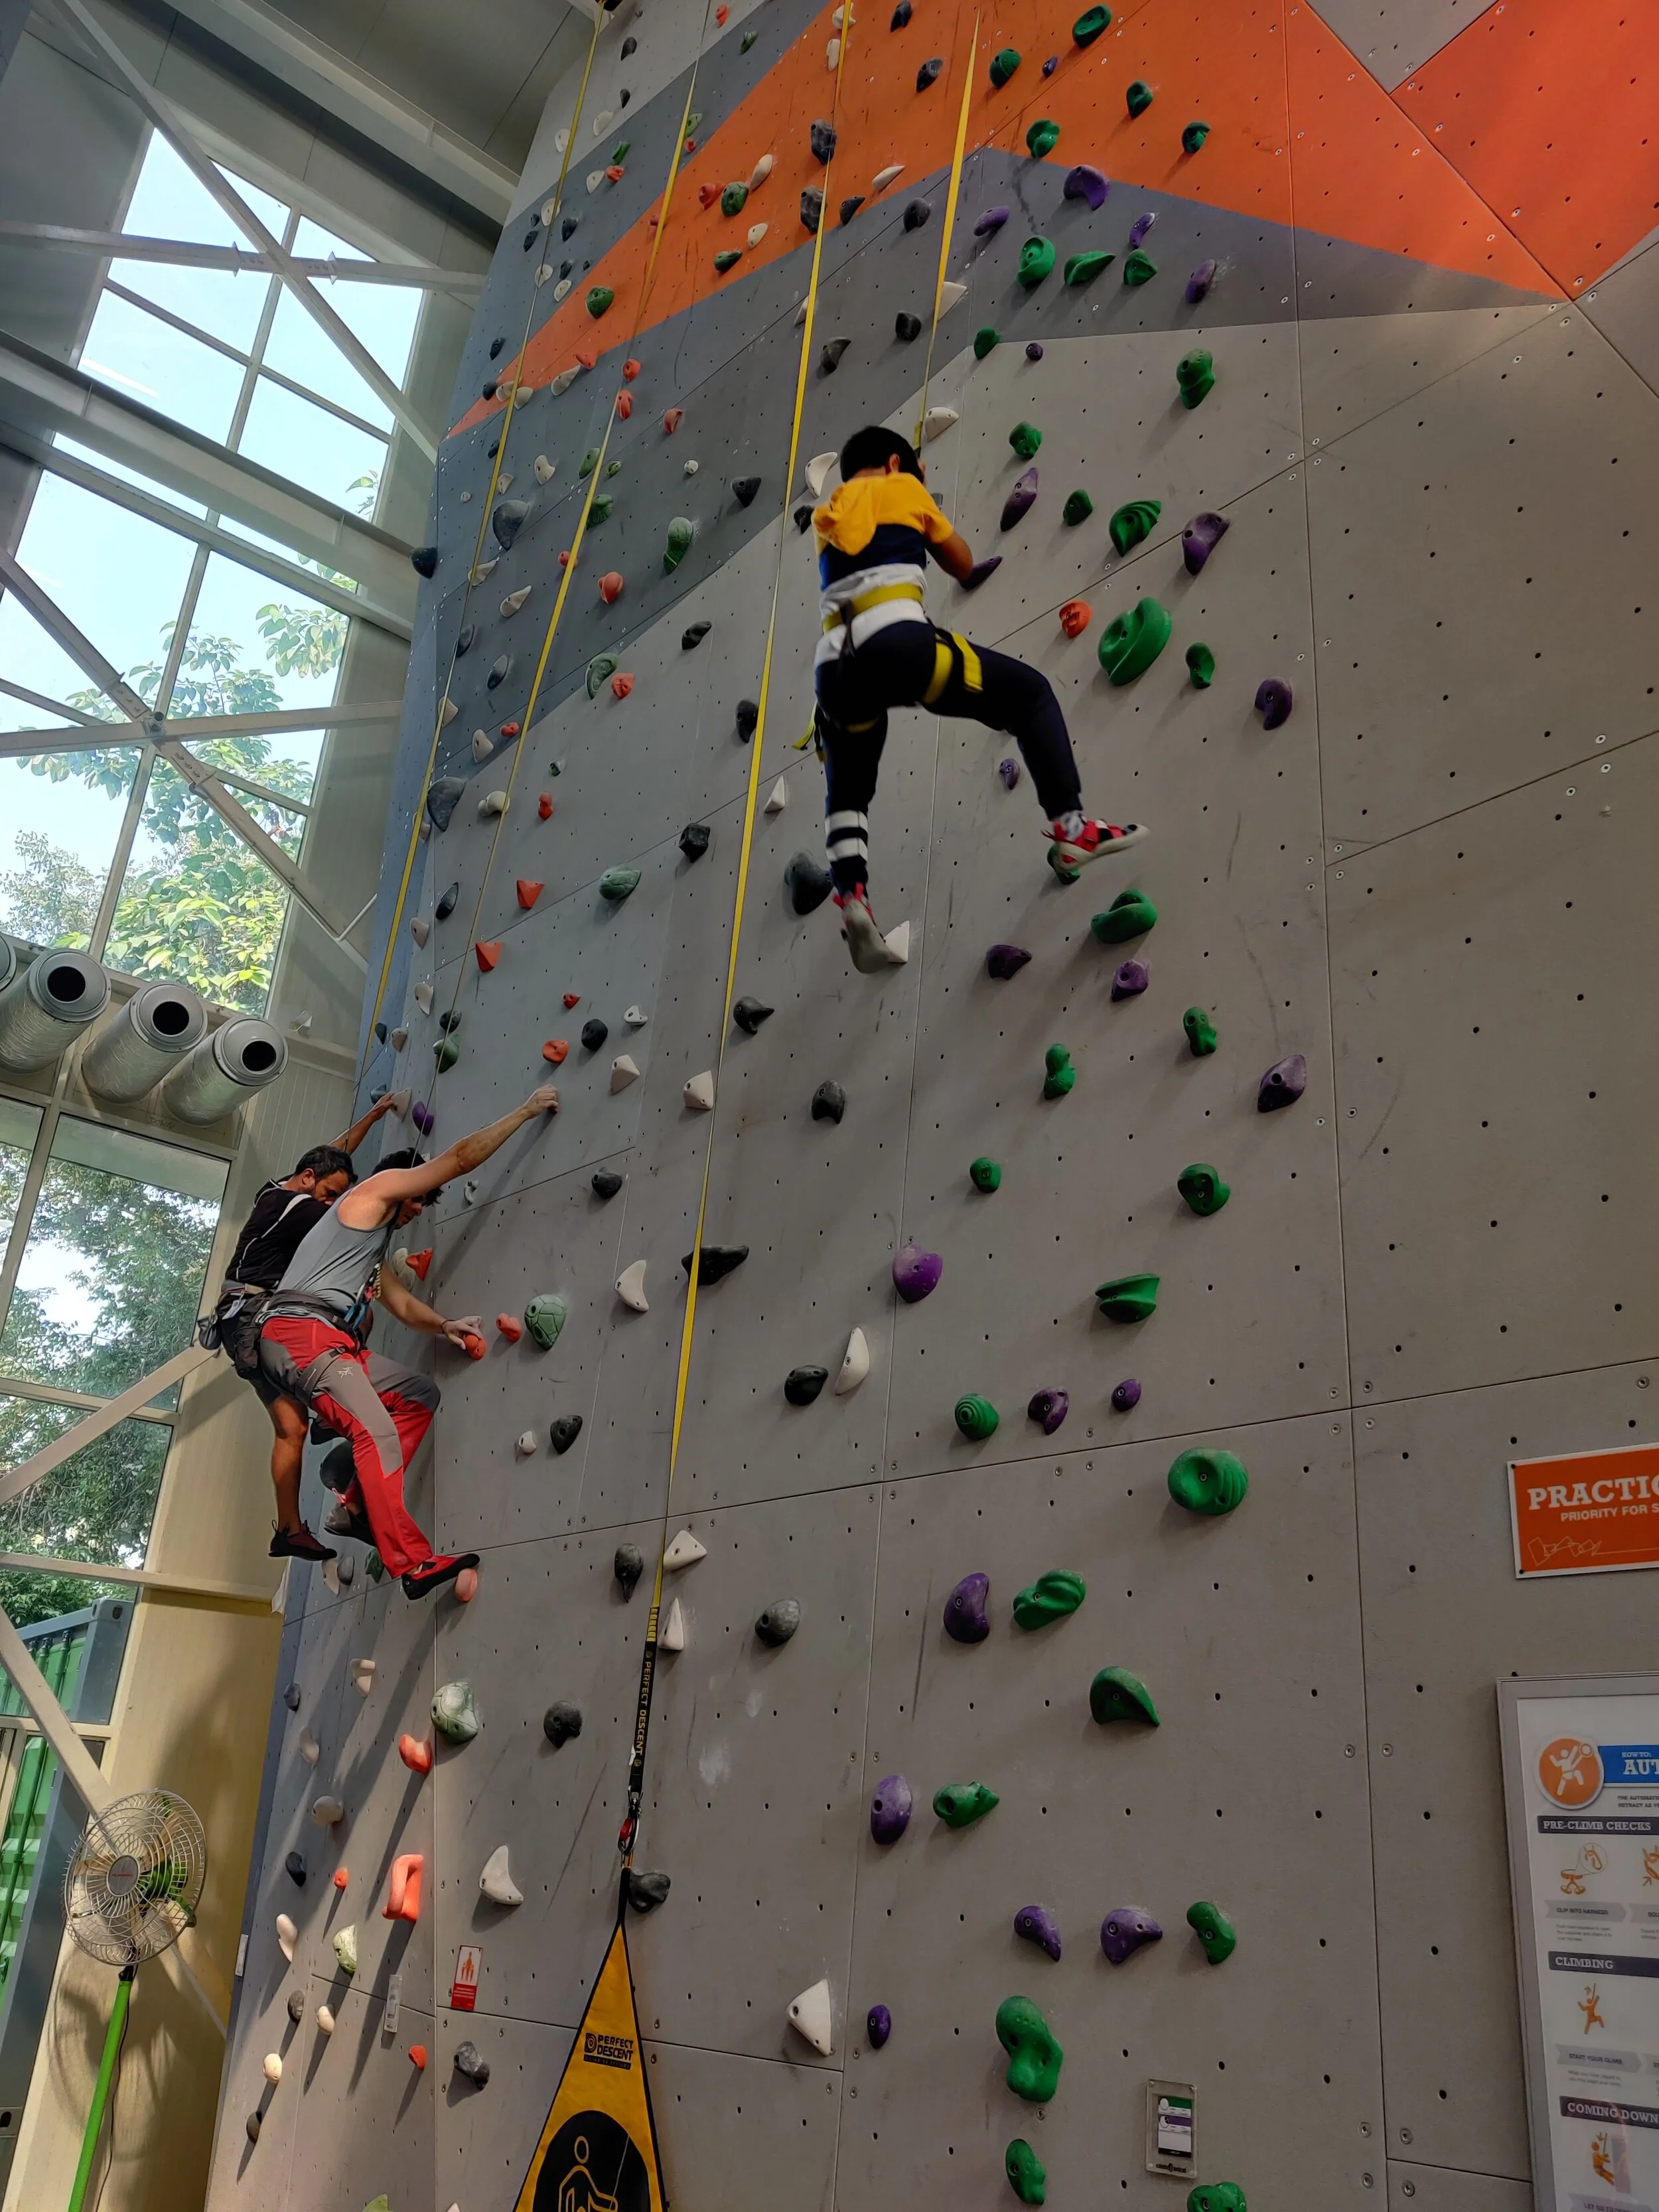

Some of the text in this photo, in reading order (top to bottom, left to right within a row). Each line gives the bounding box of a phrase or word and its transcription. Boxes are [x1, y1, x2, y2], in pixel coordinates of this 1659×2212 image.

[1561, 1507, 1618, 1522] PRIORITY
[1622, 1504, 1648, 1516] FOR
[635, 1662, 652, 1755] PERFECT DESCENT
[1543, 1820, 1652, 1831] PRE-CLIMB CHECKS
[1555, 1956, 1614, 1969] CLIMBING
[597, 2034, 634, 2049] PERFECT
[597, 2044, 634, 2061] DESCENT
[1567, 2102, 1659, 2123] COMING DOWN
